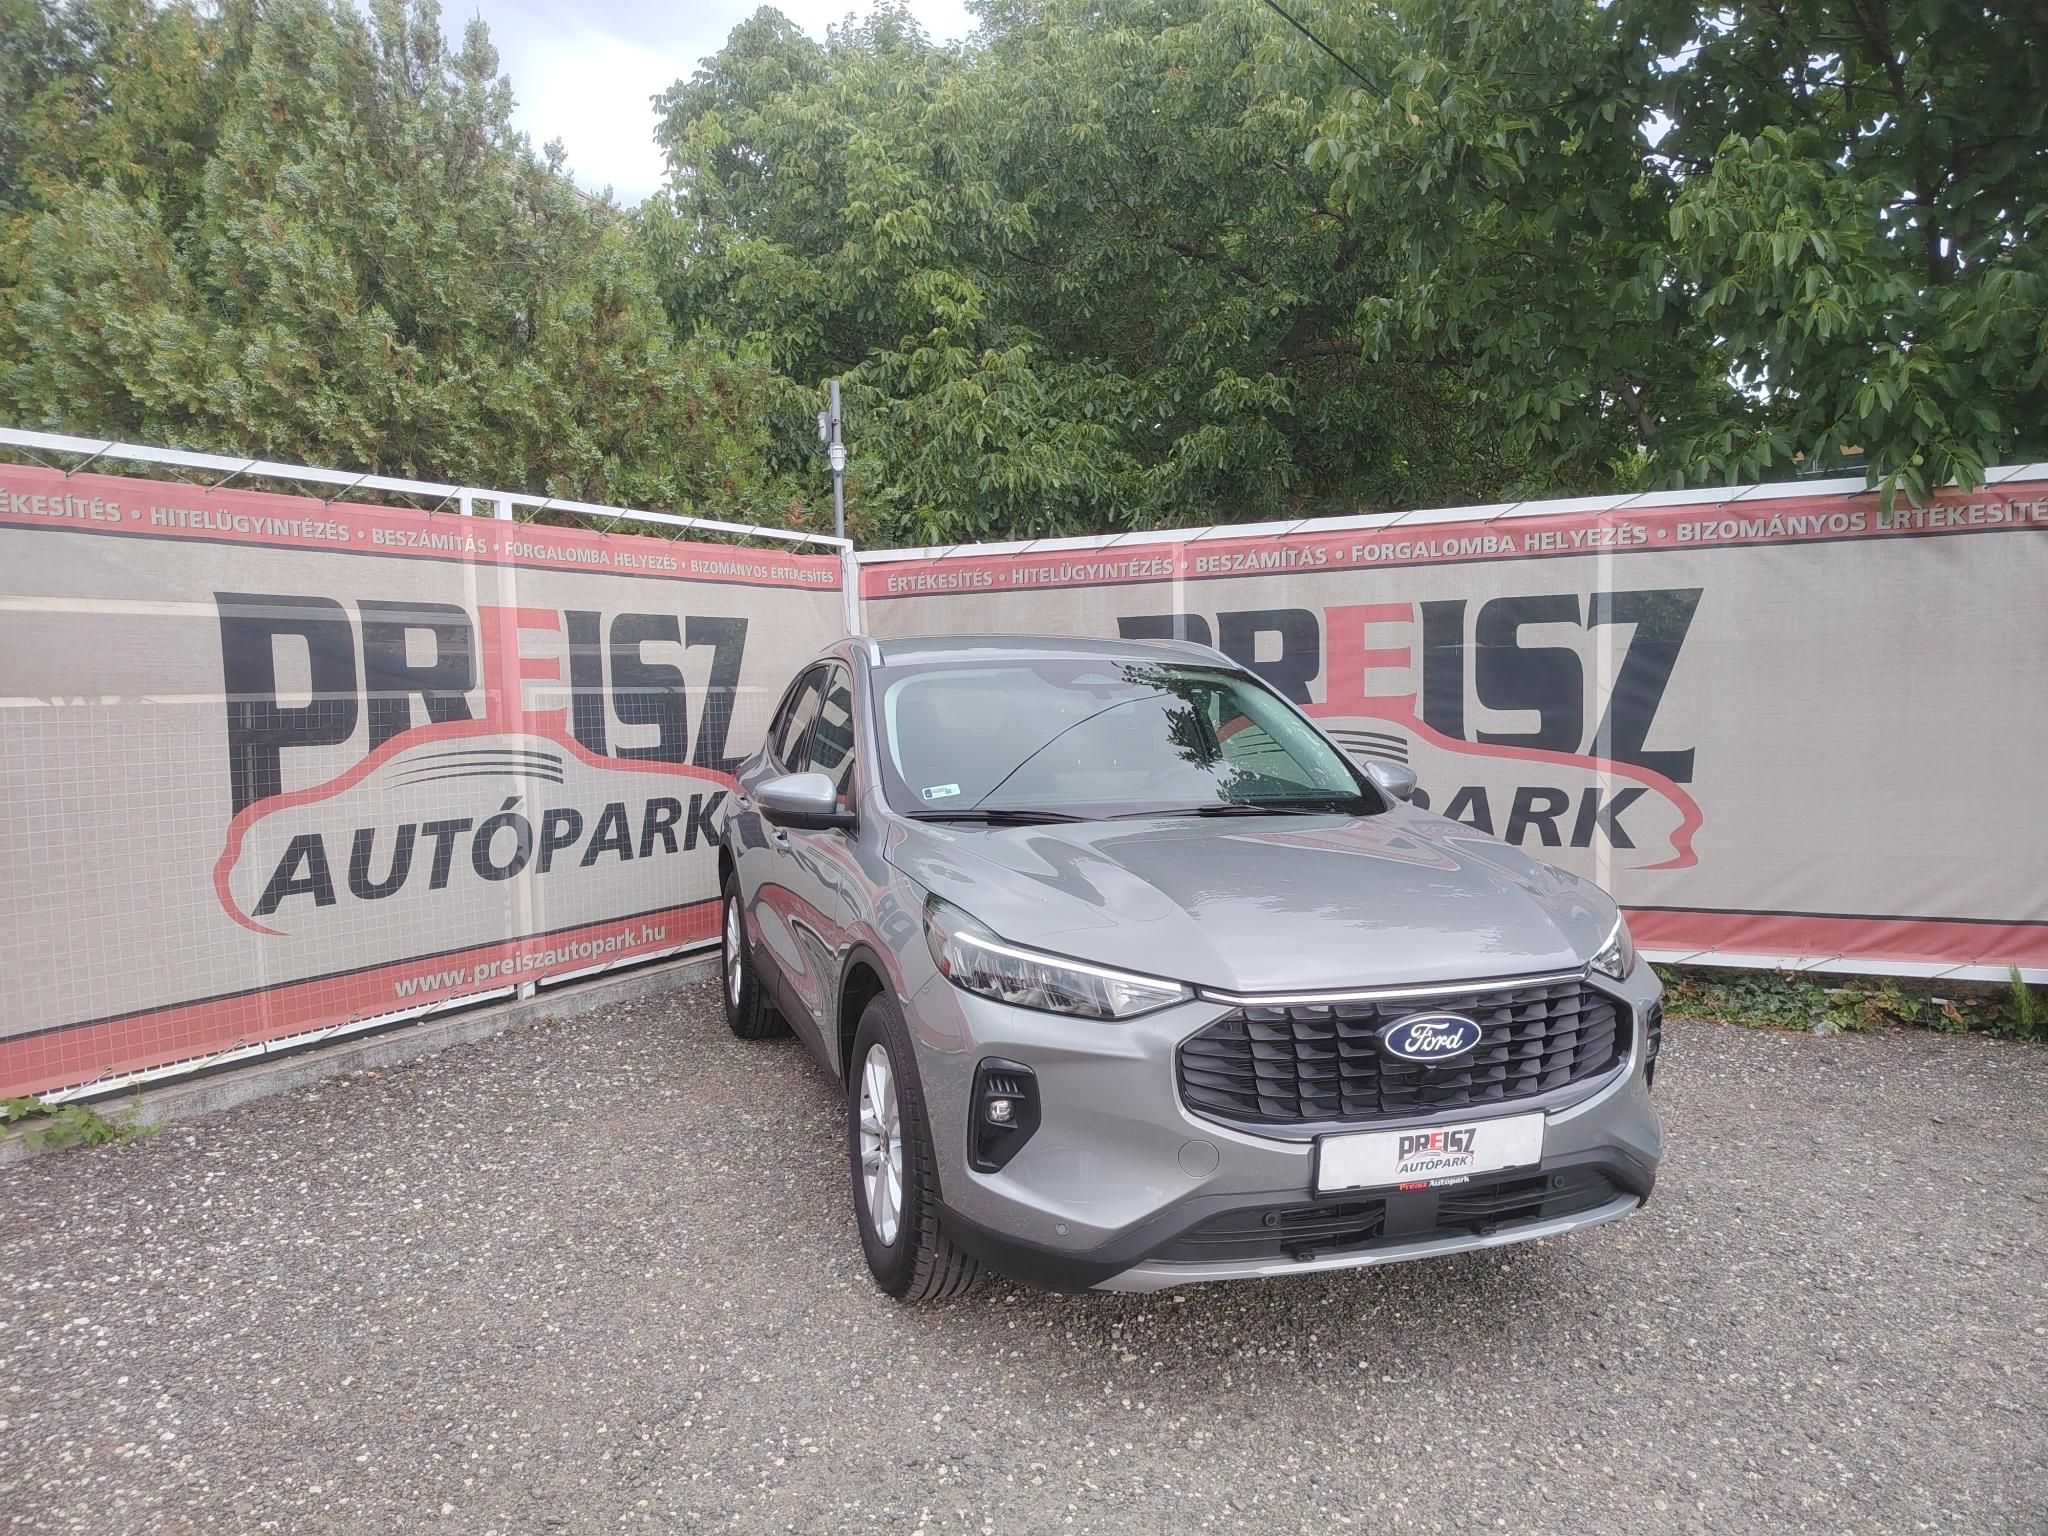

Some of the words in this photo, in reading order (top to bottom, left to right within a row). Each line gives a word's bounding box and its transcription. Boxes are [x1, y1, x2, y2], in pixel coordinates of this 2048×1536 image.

[150, 506, 351, 542] HITELÜGYINTÉZÉS
[371, 526, 487, 555] BESZÁMÍTÁS
[505, 541, 610, 565] FORGALOMBA
[614, 551, 677, 571] HELYEZÉS
[690, 559, 768, 579] BIZOMÁNYOS
[771, 564, 834, 583] ÉRTÉKESÍTÉS
[887, 567, 992, 593] ÉRTÉKESÍTÉS
[1011, 557, 1174, 584] HITELÜGYINTÉZÉS
[1196, 546, 1327, 572] BESZÁMÍTÁS
[1352, 536, 1517, 562] FORGALOMBA
[1524, 525, 1648, 552] HELYEZÉS
[1676, 511, 1867, 542] BIZOMÁNYOS
[213, 591, 752, 818] PREISZ
[1411, 786, 1651, 849] ARK
[251, 790, 728, 917] AUTÓPARK
[394, 924, 667, 998] www.preiszautopark.hu
[1405, 1023, 1464, 1052] Ford
[1399, 1128, 1477, 1161] PREISZ
[1400, 1156, 1469, 1174] AUTÓPARK
[1400, 1182, 1428, 1191] Preisz
[1429, 1176, 1470, 1188] Autopark
